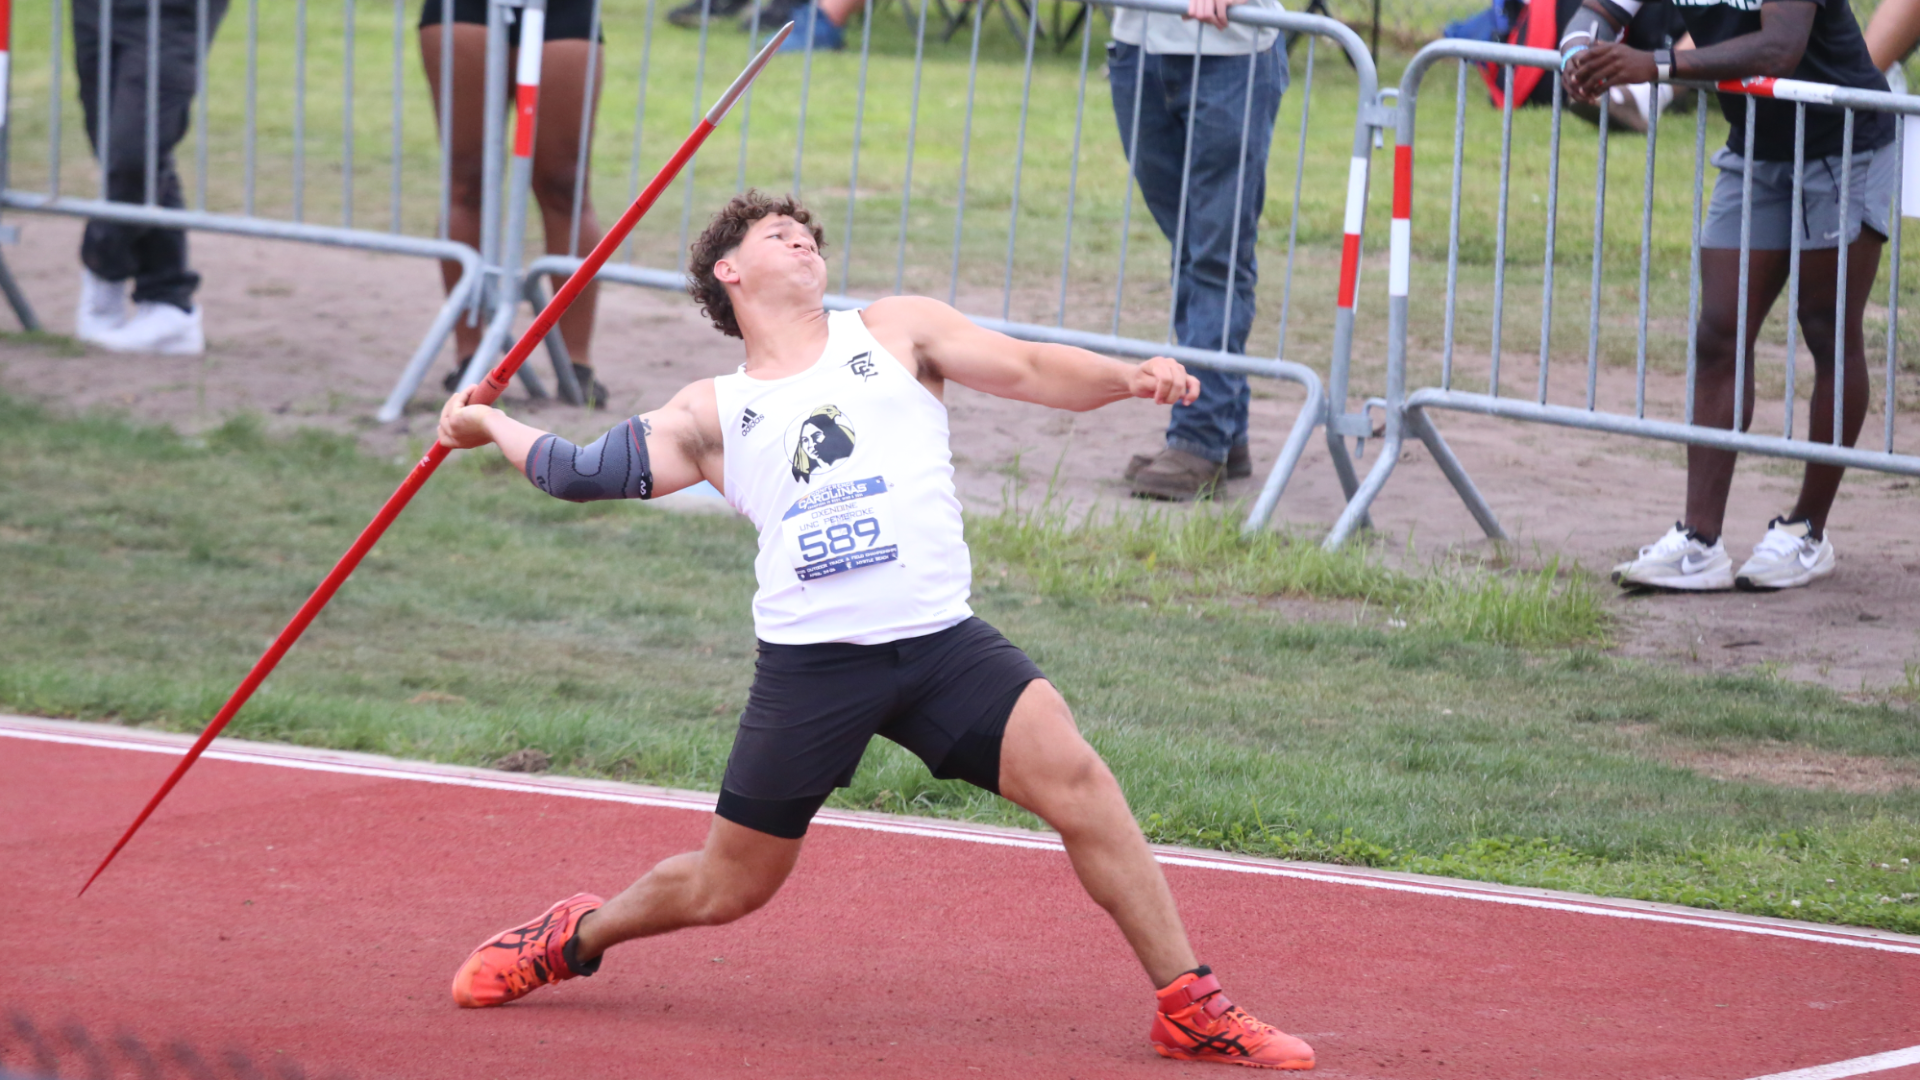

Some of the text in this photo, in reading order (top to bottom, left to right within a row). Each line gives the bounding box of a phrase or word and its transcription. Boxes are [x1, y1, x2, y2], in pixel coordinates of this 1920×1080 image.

[741, 413, 765, 437] adidas
[798, 482, 868, 510] CAROLINAS
[799, 507, 875, 532] UNC PEMBROKE
[811, 501, 858, 519] OXENDINE
[797, 516, 881, 562] 589
